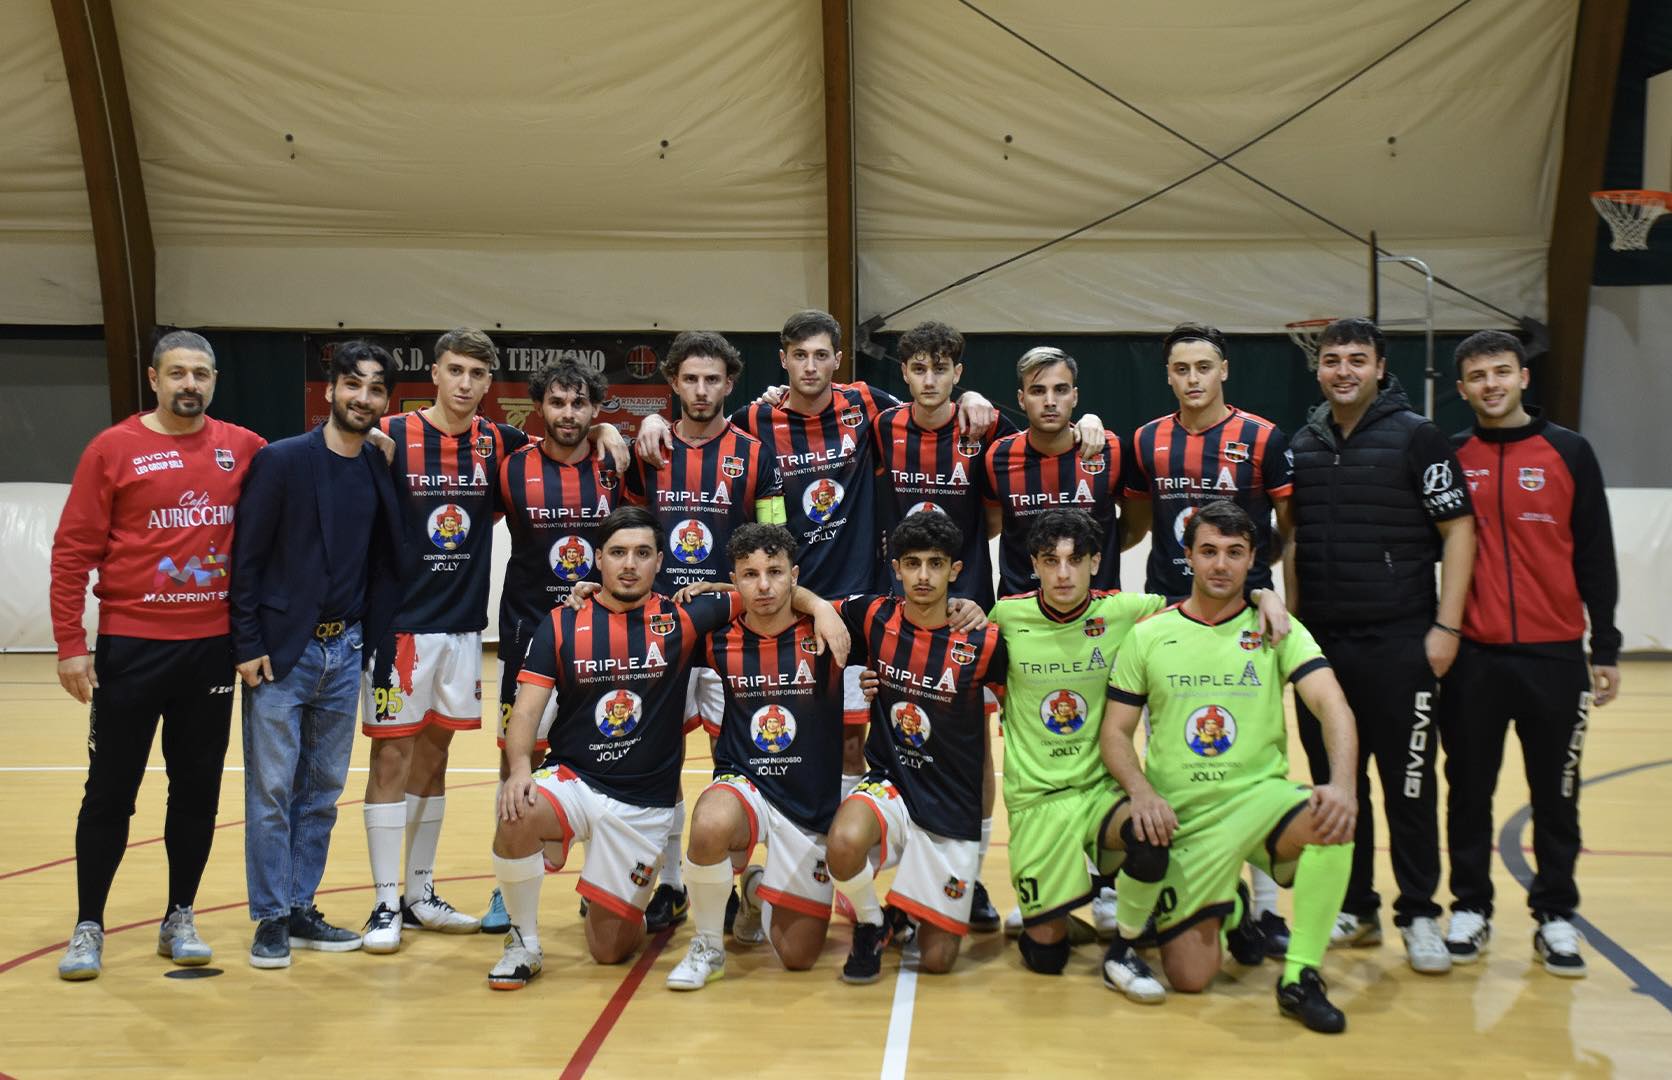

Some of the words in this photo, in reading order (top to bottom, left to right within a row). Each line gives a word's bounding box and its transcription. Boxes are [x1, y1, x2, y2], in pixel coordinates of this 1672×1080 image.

[133, 450, 180, 465] GIVOVA
[783, 466, 816, 477] INNOVATIVE
[924, 487, 966, 496] PERFORMANCE
[147, 505, 235, 529] AURICCHIO
[808, 529, 838, 545] JOLLY
[431, 562, 460, 572] JOLLY
[673, 576, 705, 586] JOLLY
[143, 592, 217, 603] MAXPRINT
[579, 675, 616, 684] INNOVATIVE
[617, 671, 664, 681] PERFORMANCE
[735, 690, 767, 698] INNOVATIVE
[767, 688, 813, 697] PERFORMANCE
[908, 687, 953, 704] PERFORMANCE
[374, 687, 404, 714] 95
[589, 742, 612, 751] CENTRO
[1403, 691, 1432, 799] GIVOVA
[1561, 691, 1593, 798] GIVOVA
[596, 747, 631, 763] JOLLY
[1049, 745, 1082, 758] JOLLY
[749, 757, 770, 765] CENTRO
[770, 756, 802, 764] INGROSSO
[899, 755, 924, 769] OLLY
[755, 766, 788, 776] JOLLY
[1190, 771, 1227, 782] JOLLY
